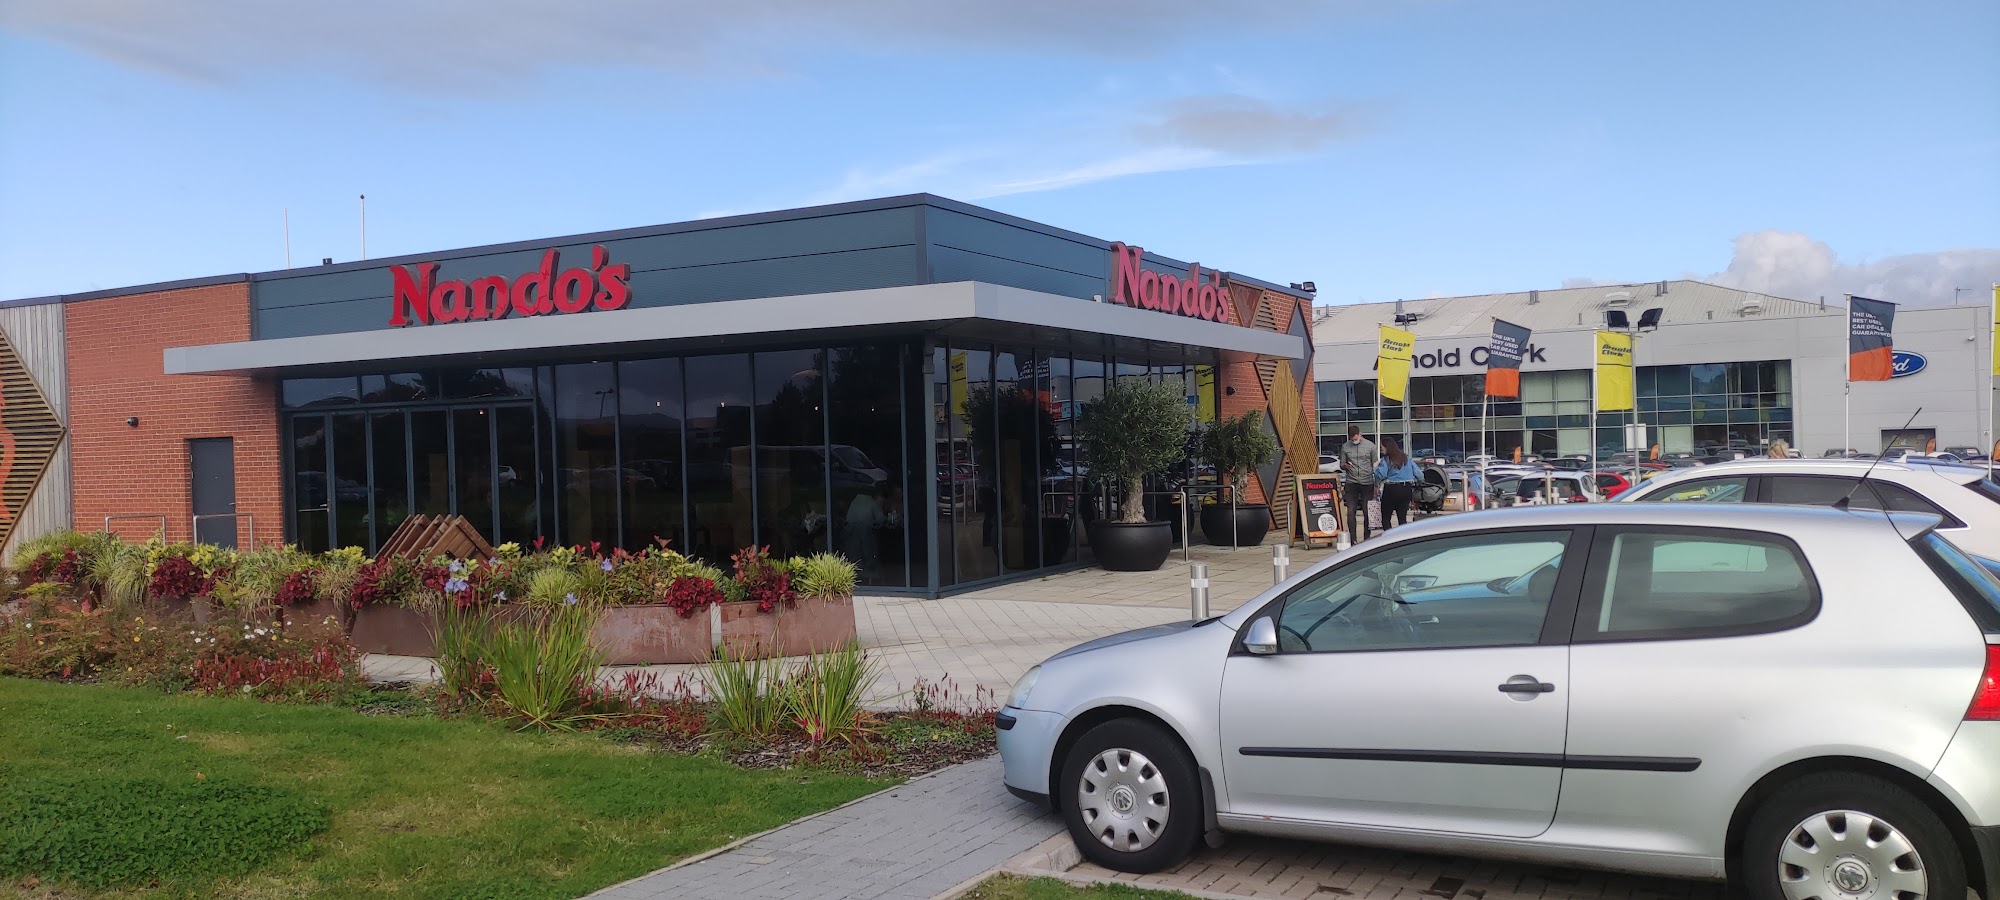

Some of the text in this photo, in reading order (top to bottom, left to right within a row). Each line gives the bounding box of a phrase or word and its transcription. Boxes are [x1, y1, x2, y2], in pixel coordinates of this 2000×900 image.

[389, 244, 632, 327] Nando's
[1107, 241, 1229, 323] Nando's
[1382, 343, 1403, 352] Clark
[1383, 338, 1410, 348] Arnold
[1491, 349, 1522, 361] UARANTEED
[1501, 346, 1518, 354] DEALS
[1372, 347, 1461, 371] nold
